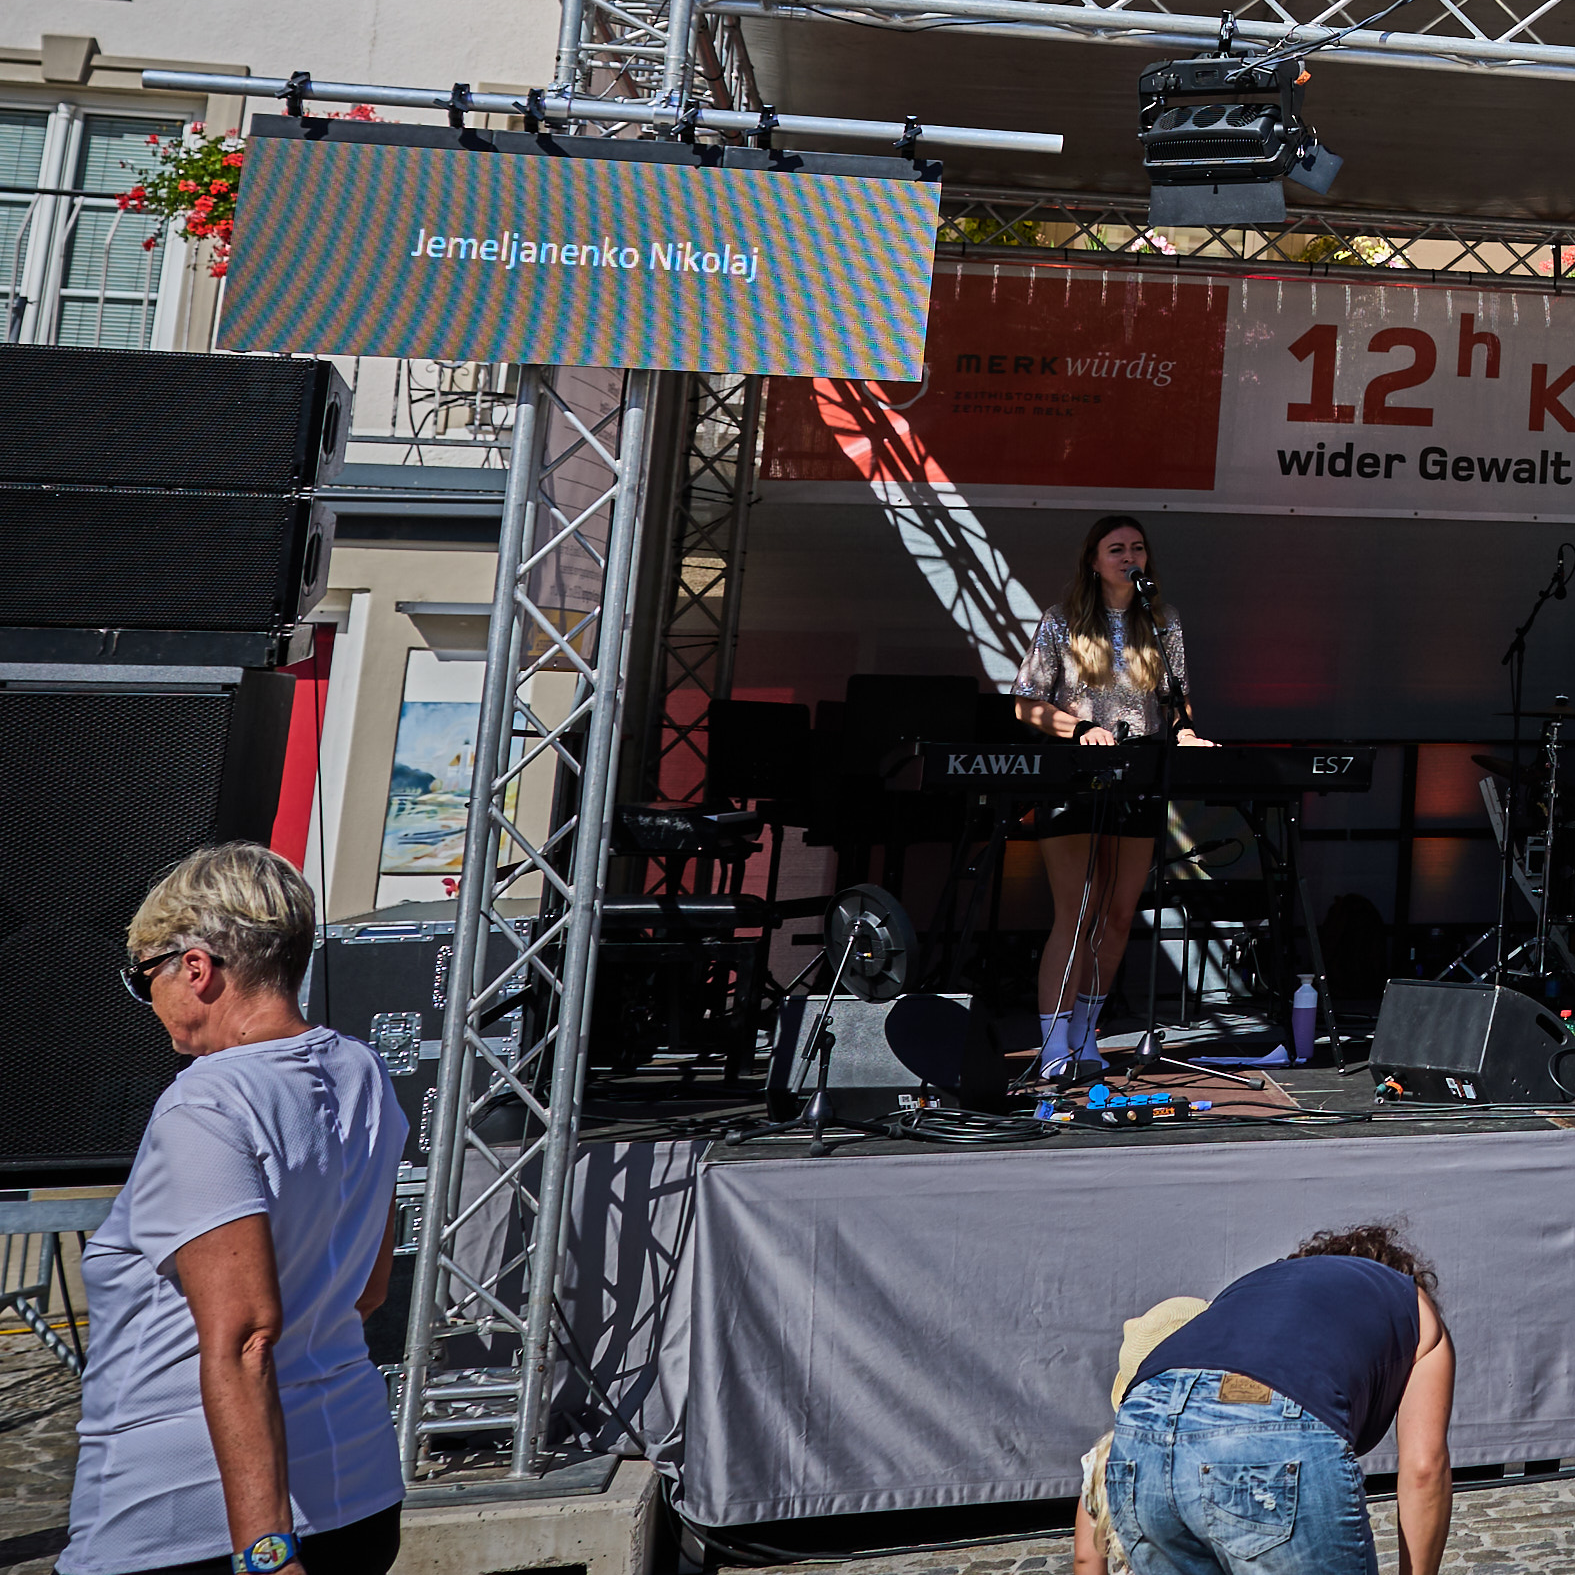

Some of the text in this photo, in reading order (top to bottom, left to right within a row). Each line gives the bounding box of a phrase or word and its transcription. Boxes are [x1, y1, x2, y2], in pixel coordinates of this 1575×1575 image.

[410, 228, 760, 284] Jemeljanenko Nikolaj
[1277, 442, 1406, 479] wider
[1418, 445, 1573, 486] Gewalt
[946, 754, 1042, 776] KAWAI
[1312, 756, 1354, 775] ES7
